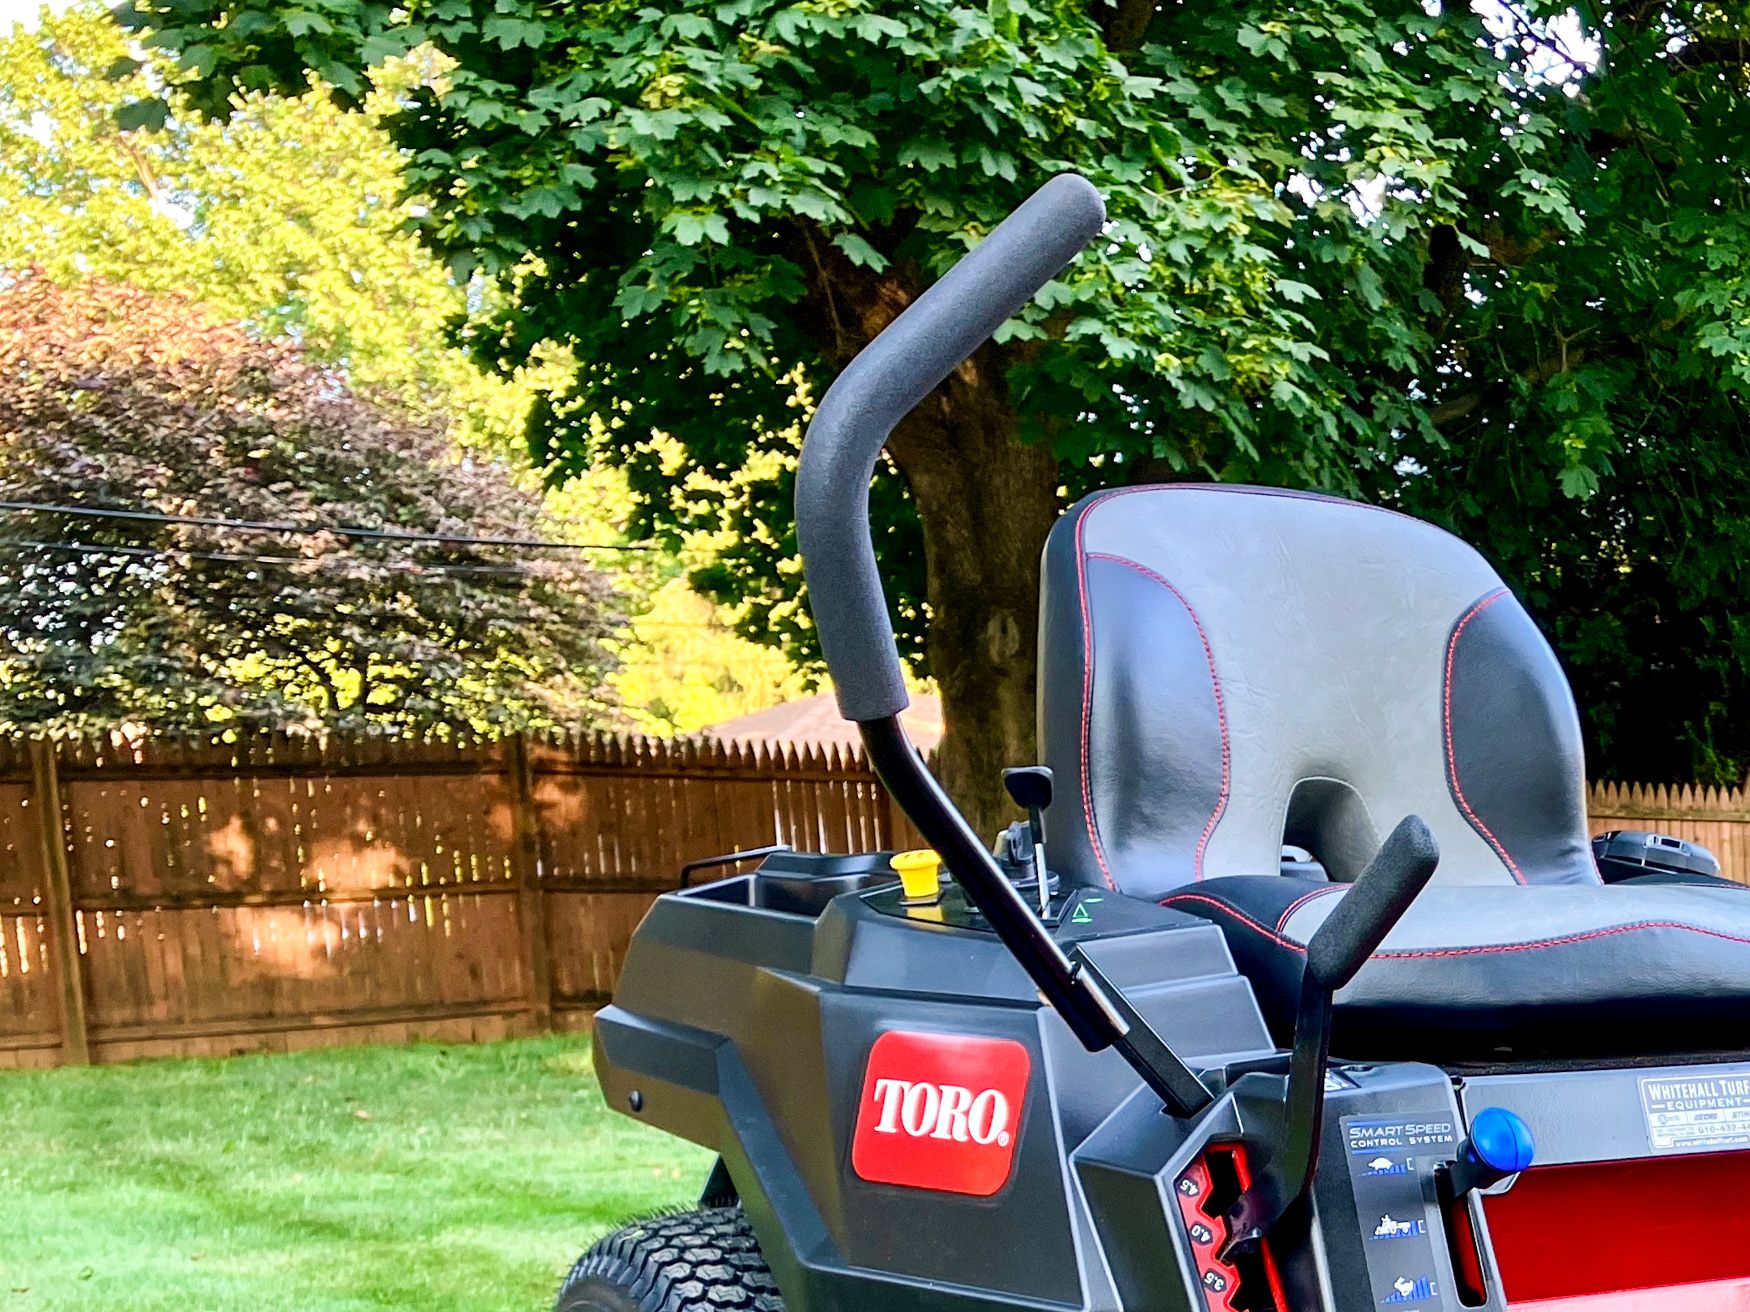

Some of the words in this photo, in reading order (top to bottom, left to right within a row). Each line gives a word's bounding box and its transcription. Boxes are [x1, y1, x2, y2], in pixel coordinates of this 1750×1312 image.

[1648, 1081, 1719, 1101] WHITEHALL
[1718, 1079, 1750, 1097] TURF
[1666, 1097, 1742, 1111] EQUIPMENT
[1349, 1126, 1403, 1139] SMART
[1405, 1123, 1451, 1135] SPEED
[1350, 1138, 1402, 1149] CONTROL
[1408, 1135, 1453, 1145] SYSTEM
[1180, 1179, 1199, 1196] 4.5
[1191, 1224, 1211, 1243] 4.0
[1204, 1272, 1225, 1291] 3.5
